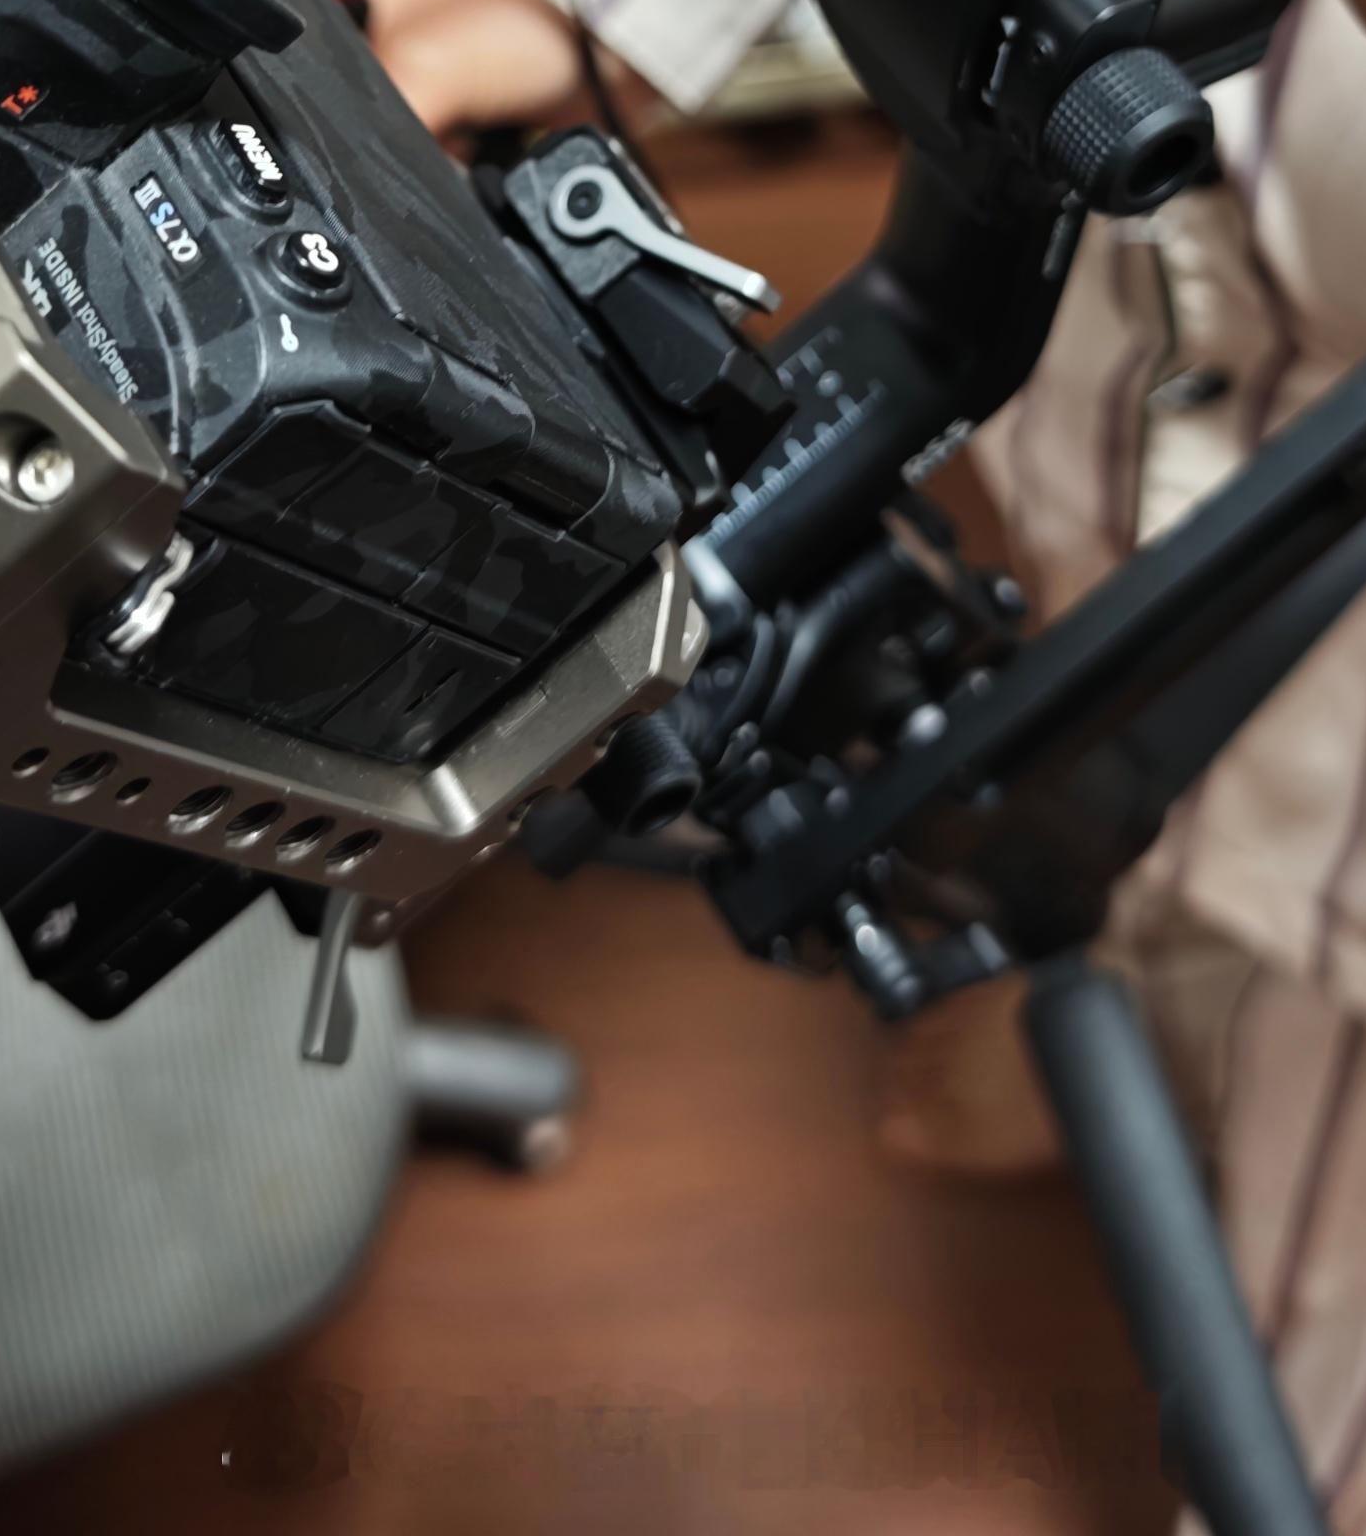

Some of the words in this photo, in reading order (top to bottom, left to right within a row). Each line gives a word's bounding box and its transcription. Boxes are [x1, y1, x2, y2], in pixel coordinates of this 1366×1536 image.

[230, 123, 283, 180] MENU
[37, 237, 84, 307] INSIDE
[301, 233, 339, 272] C3
[75, 300, 139, 404] SteadyShot
